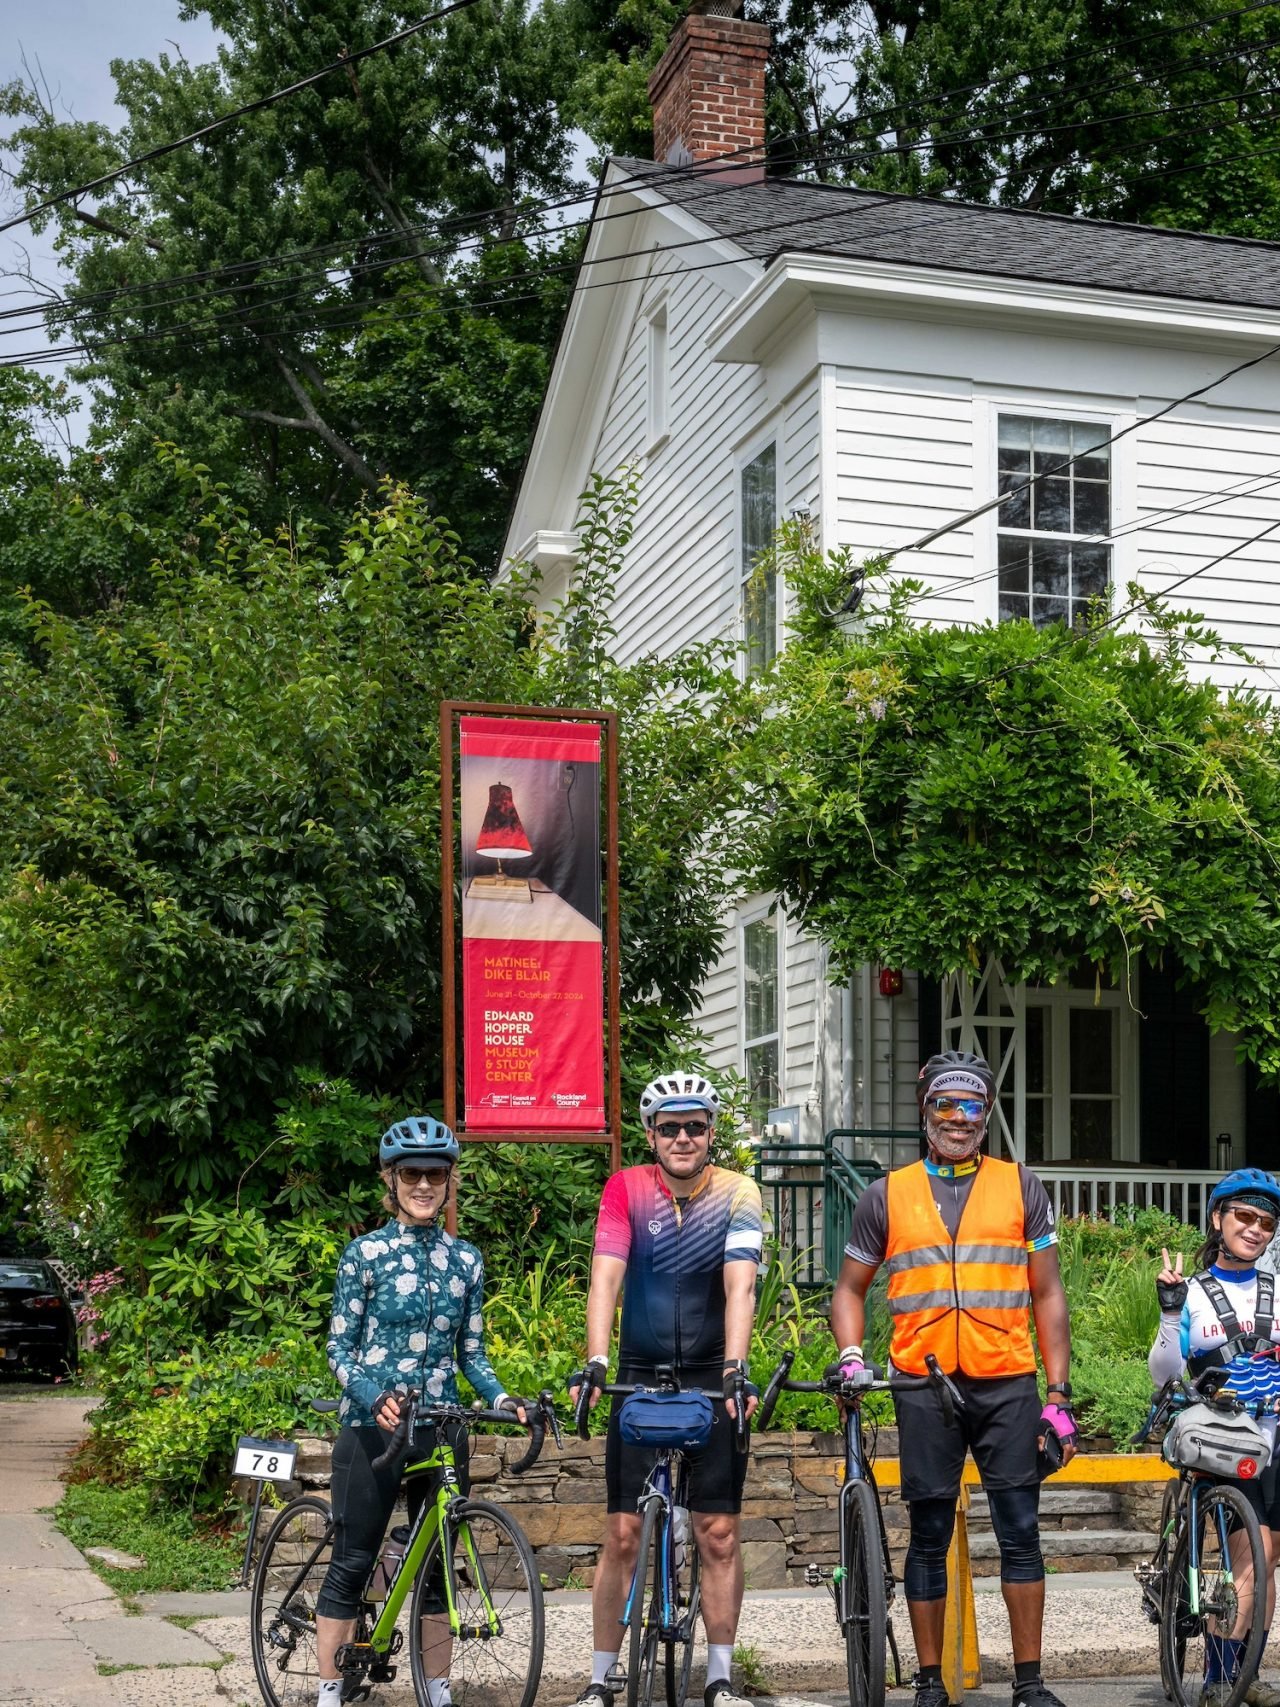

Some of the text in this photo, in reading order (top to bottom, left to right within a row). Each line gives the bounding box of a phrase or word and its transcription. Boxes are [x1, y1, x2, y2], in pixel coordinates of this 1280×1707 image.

[484, 956, 541, 969] MATINEE:
[484, 968, 551, 981] DIKE BLAIR
[485, 989, 504, 998] June
[519, 990, 552, 999] October
[563, 992, 584, 1000] 2024
[484, 1010, 534, 1022] EDWARD
[484, 1022, 532, 1034] HOPPER
[484, 1034, 525, 1046] HOUSE
[485, 1047, 539, 1058] MUSEUM
[485, 1059, 533, 1070] & STUDY
[486, 1071, 534, 1082] CENTER
[934, 1076, 983, 1090] BROOKLYN
[252, 1453, 279, 1473] 78
